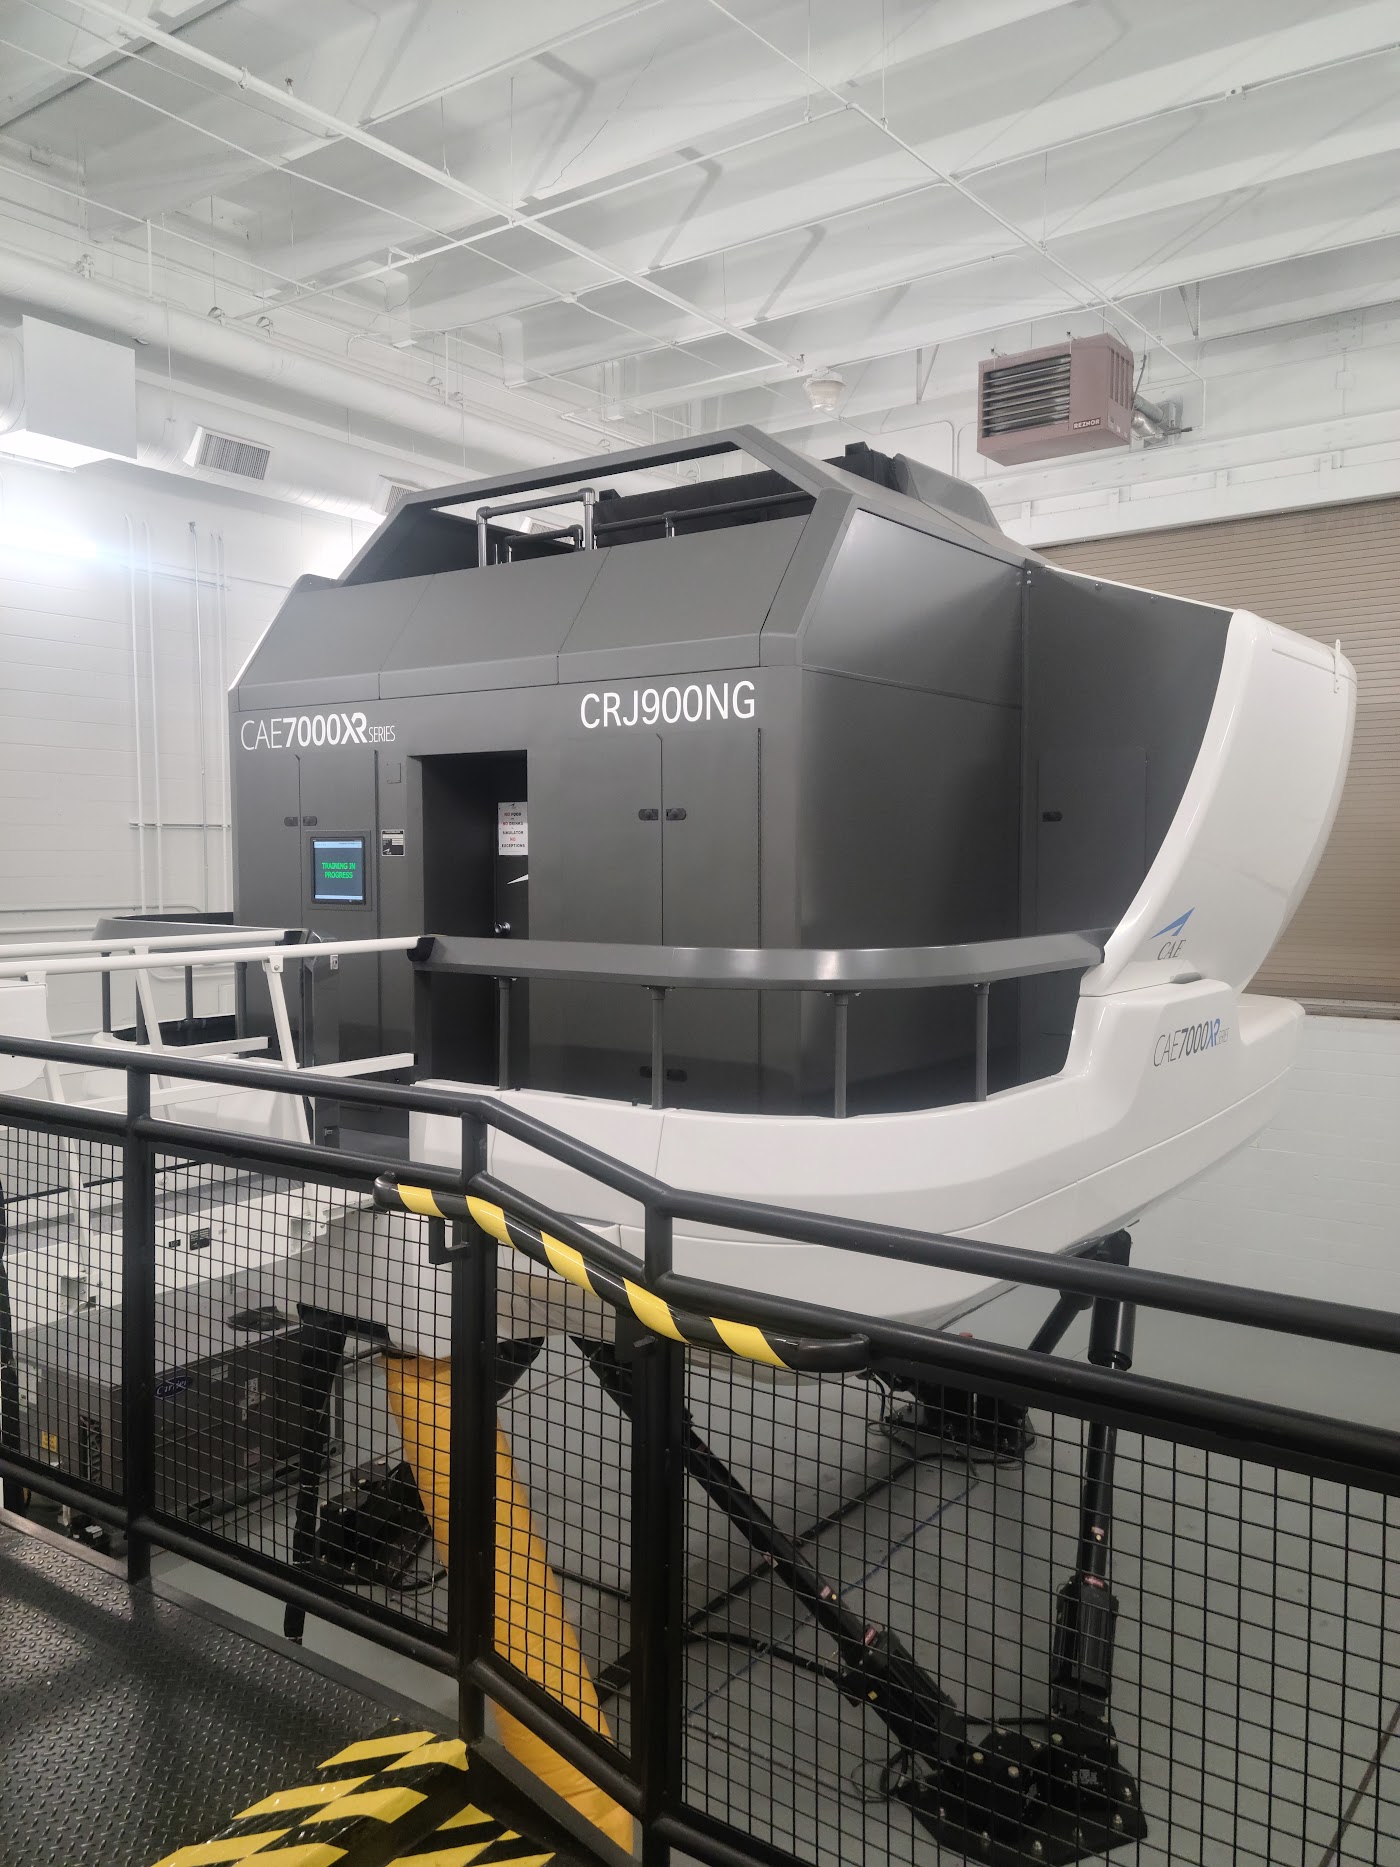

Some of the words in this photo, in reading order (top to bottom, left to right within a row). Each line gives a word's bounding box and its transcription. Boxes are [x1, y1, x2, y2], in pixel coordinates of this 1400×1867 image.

[1073, 419, 1100, 429] REZNOR
[580, 680, 755, 729] CRJ900NG
[368, 725, 396, 743] SERIES
[321, 862, 348, 870] TRAINING
[348, 862, 356, 870] IN
[324, 871, 353, 879] PROGRESS
[1157, 940, 1187, 961] CAE
